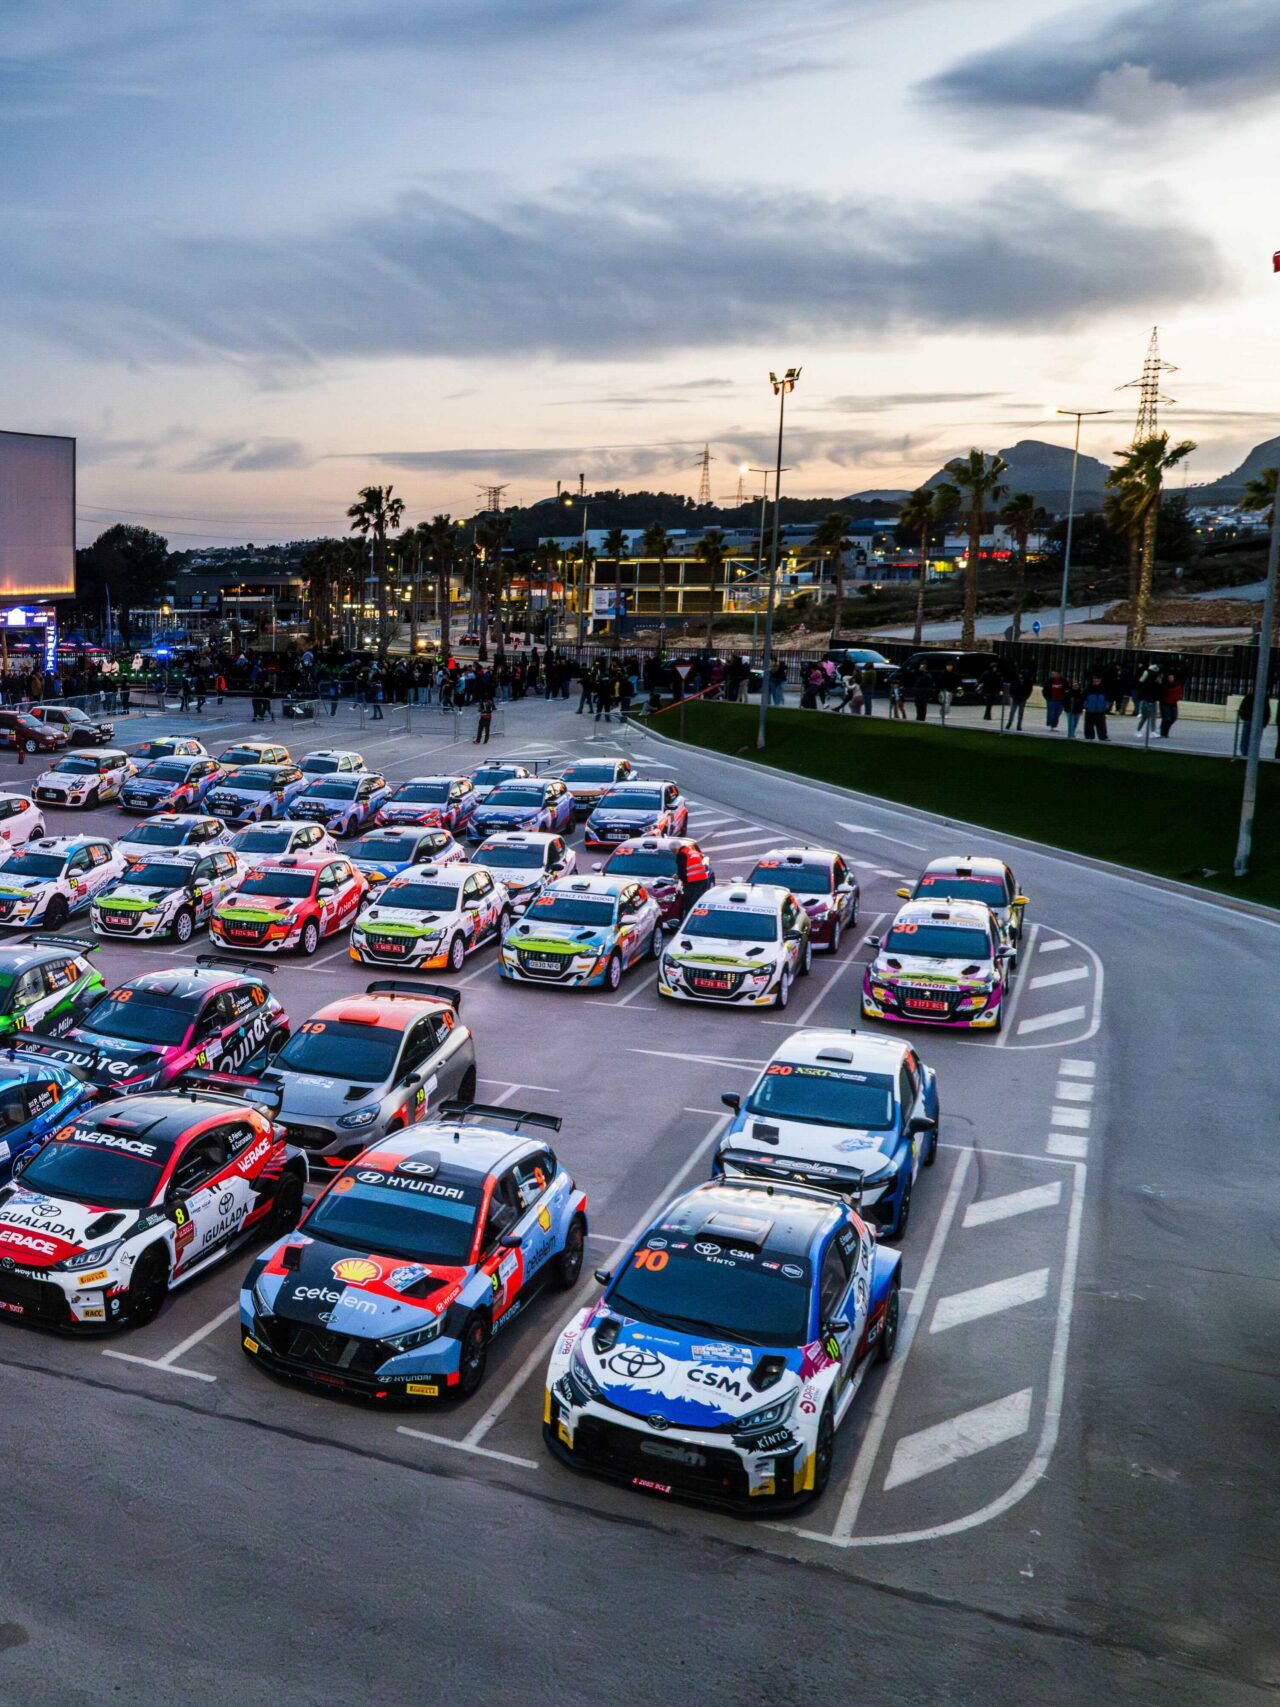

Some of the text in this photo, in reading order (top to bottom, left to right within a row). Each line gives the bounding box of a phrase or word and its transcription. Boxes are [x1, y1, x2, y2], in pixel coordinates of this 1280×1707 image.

[760, 860, 780, 868] 32
[536, 897, 556, 906] 28
[893, 924, 918, 934] 30
[64, 963, 78, 982] 17
[111, 988, 134, 1002] 18
[251, 984, 266, 1006] 18
[910, 981, 949, 991] TAMOIL
[15, 1016, 26, 1030] 17
[301, 1022, 327, 1034] 19
[196, 1052, 207, 1067] 18
[768, 1064, 794, 1076] 20
[48, 1082, 61, 1104] 7
[417, 1088, 425, 1105] 19
[75, 1128, 157, 1158] WERACE
[237, 1137, 272, 1173] WERACE
[333, 1176, 355, 1194] 9
[387, 1175, 464, 1200] HYUNDAI
[535, 1166, 545, 1192] 9
[175, 1207, 185, 1225] 8
[202, 1202, 250, 1246] IGUALADA
[526, 1234, 557, 1275] cetelem
[634, 1249, 669, 1272] 10
[706, 1256, 737, 1267] KINTO
[729, 1248, 756, 1260] CSM
[78, 1269, 108, 1285] PIRELLI
[293, 1285, 378, 1315] cetelem
[442, 1286, 461, 1306] HYUNDAI
[84, 1309, 104, 1318] RACC
[498, 1299, 521, 1325] HYUNDAI
[826, 1336, 840, 1358] 10
[394, 1374, 432, 1382] HYUNDAI
[687, 1368, 742, 1398] CSM
[409, 1385, 437, 1395] PIRELLI
[757, 1430, 790, 1450] KINTO
